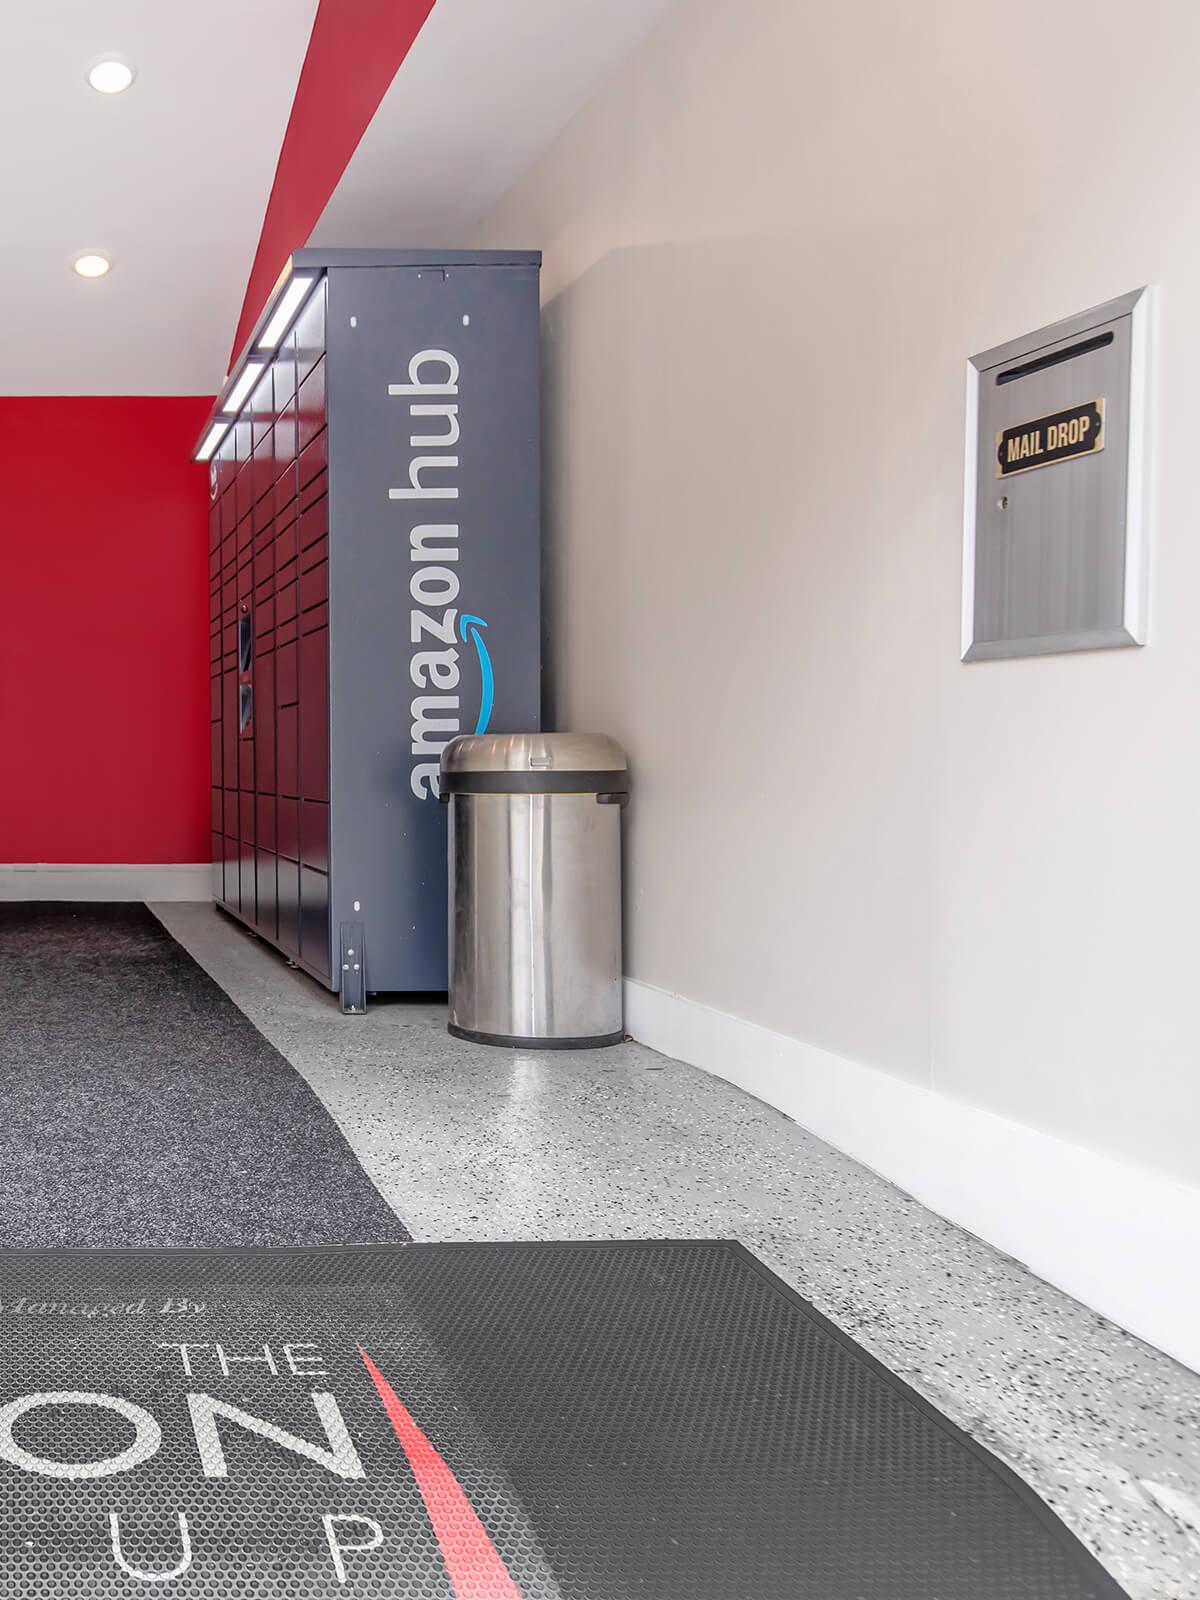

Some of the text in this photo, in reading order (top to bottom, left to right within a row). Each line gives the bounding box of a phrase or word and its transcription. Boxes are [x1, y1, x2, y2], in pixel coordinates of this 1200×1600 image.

[1008, 416, 1090, 462] MAIL DROP
[388, 349, 460, 801] amazon hub
[158, 1297, 206, 1319] By
[156, 1342, 329, 1376] THE
